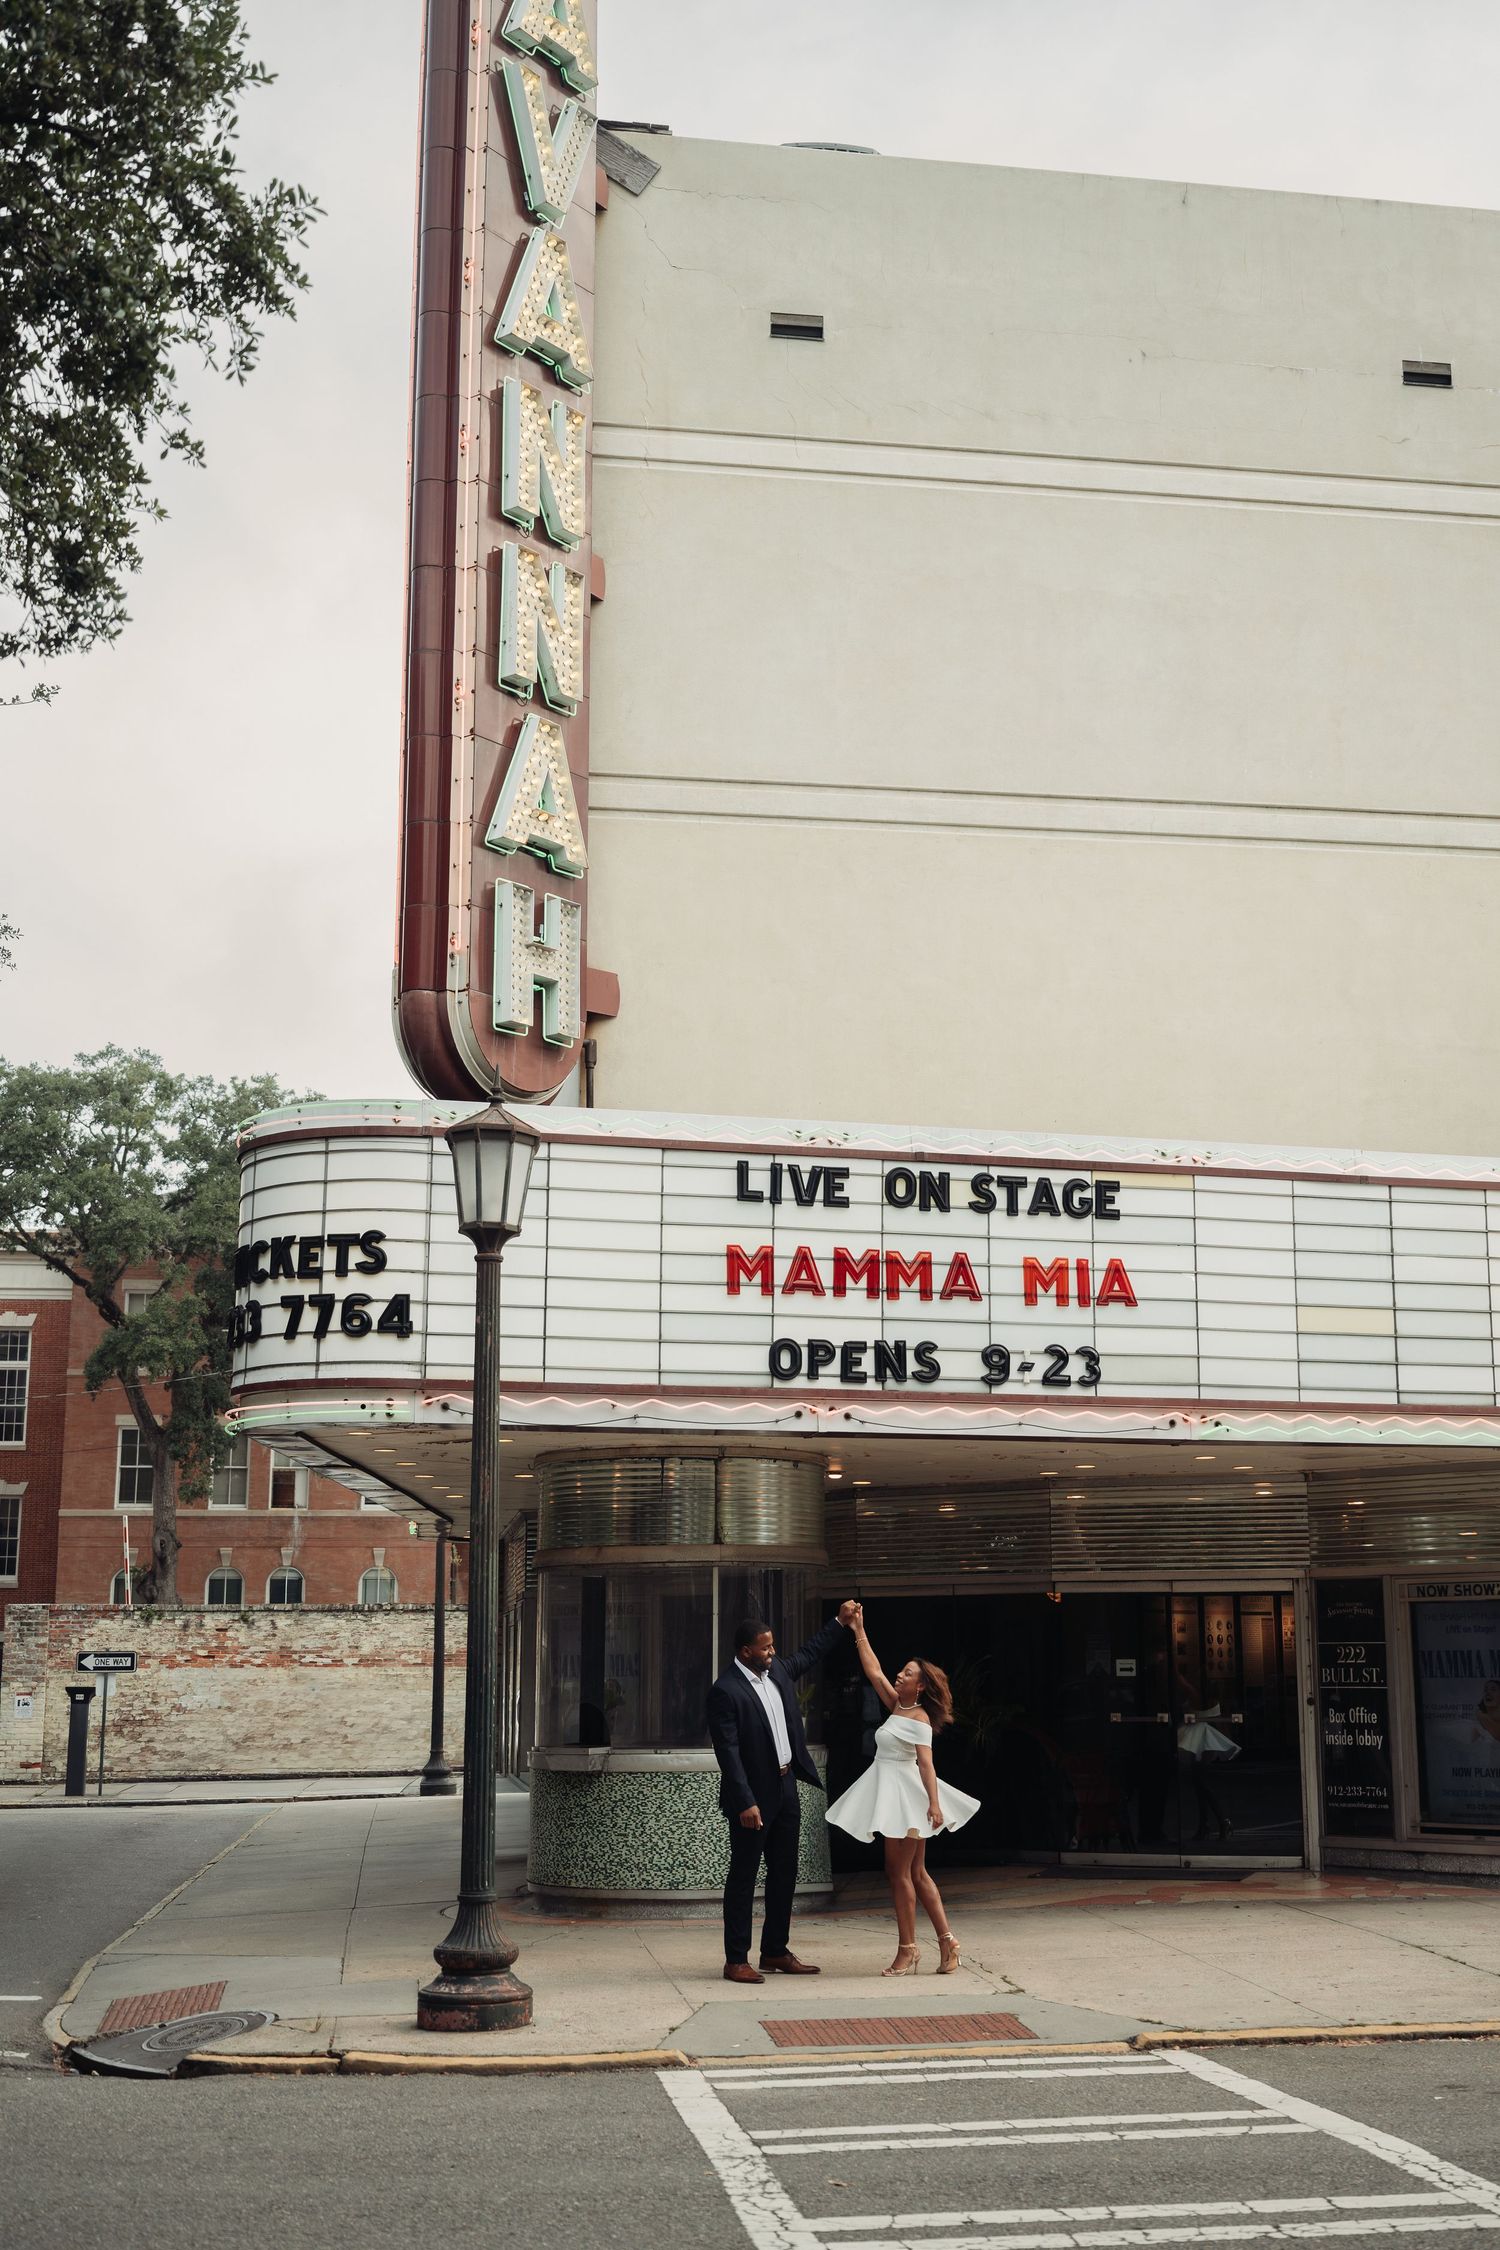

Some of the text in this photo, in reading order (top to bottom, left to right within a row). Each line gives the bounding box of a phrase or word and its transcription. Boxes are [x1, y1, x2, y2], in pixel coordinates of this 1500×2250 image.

[736, 1160, 1120, 1220] LIVE ON STAGE
[234, 1229, 387, 1290] ICKETS
[726, 1244, 1139, 1307] MAMMA MIA
[280, 1293, 413, 1340] 7764
[768, 1337, 1101, 1387] OPENS 9-23
[1416, 1585, 1448, 1597] NOW
[94, 1658, 129, 1666] ONE WAY
[1337, 1646, 1366, 1663] 222
[1322, 1667, 1384, 1683] BULL ST.
[1329, 1707, 1377, 1724] Box Office
[1325, 1729, 1383, 1750] inside lobby
[1452, 1767, 1472, 1777] NOW
[1327, 1786, 1387, 1798] 912-233-7764
